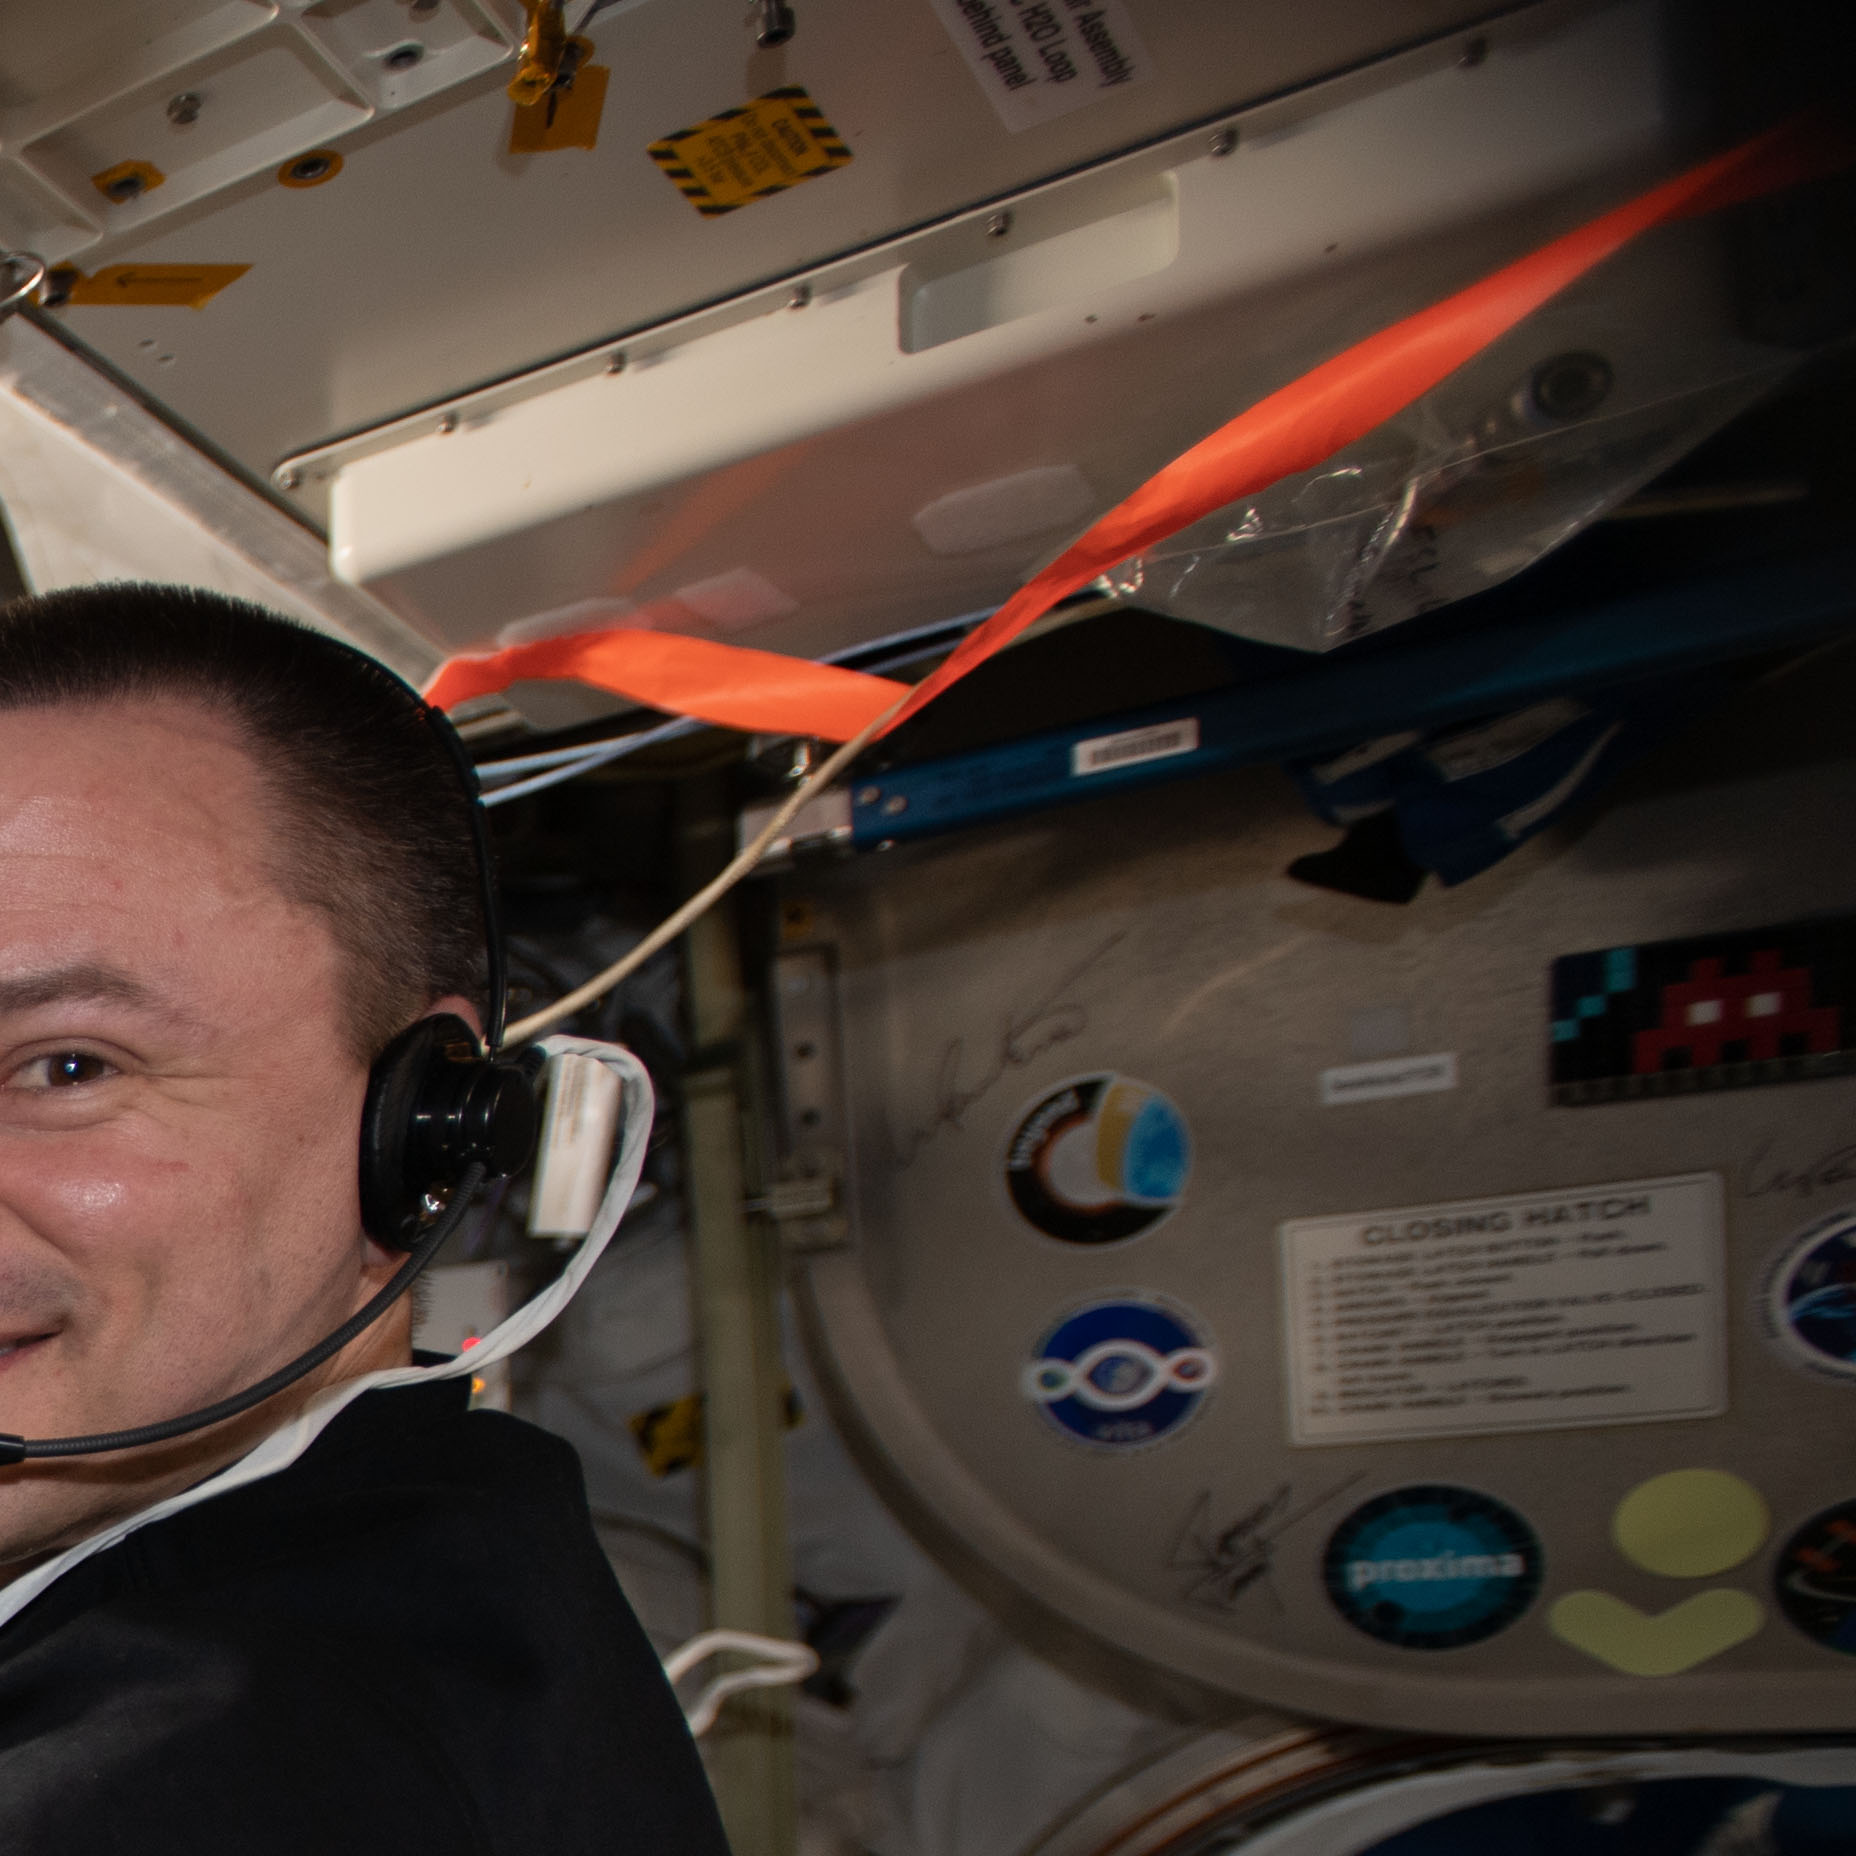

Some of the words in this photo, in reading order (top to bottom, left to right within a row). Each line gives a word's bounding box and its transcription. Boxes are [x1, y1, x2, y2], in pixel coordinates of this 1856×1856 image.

[1019, 3, 1062, 42] H2O
[980, 46, 1036, 91] panel
[1038, 38, 1077, 84] Loop
[1073, 10, 1136, 88] Assembly
[1361, 1209, 1512, 1247] CLOSING
[1523, 1195, 1650, 1227] HATCH
[1347, 1549, 1525, 1593] proxima
